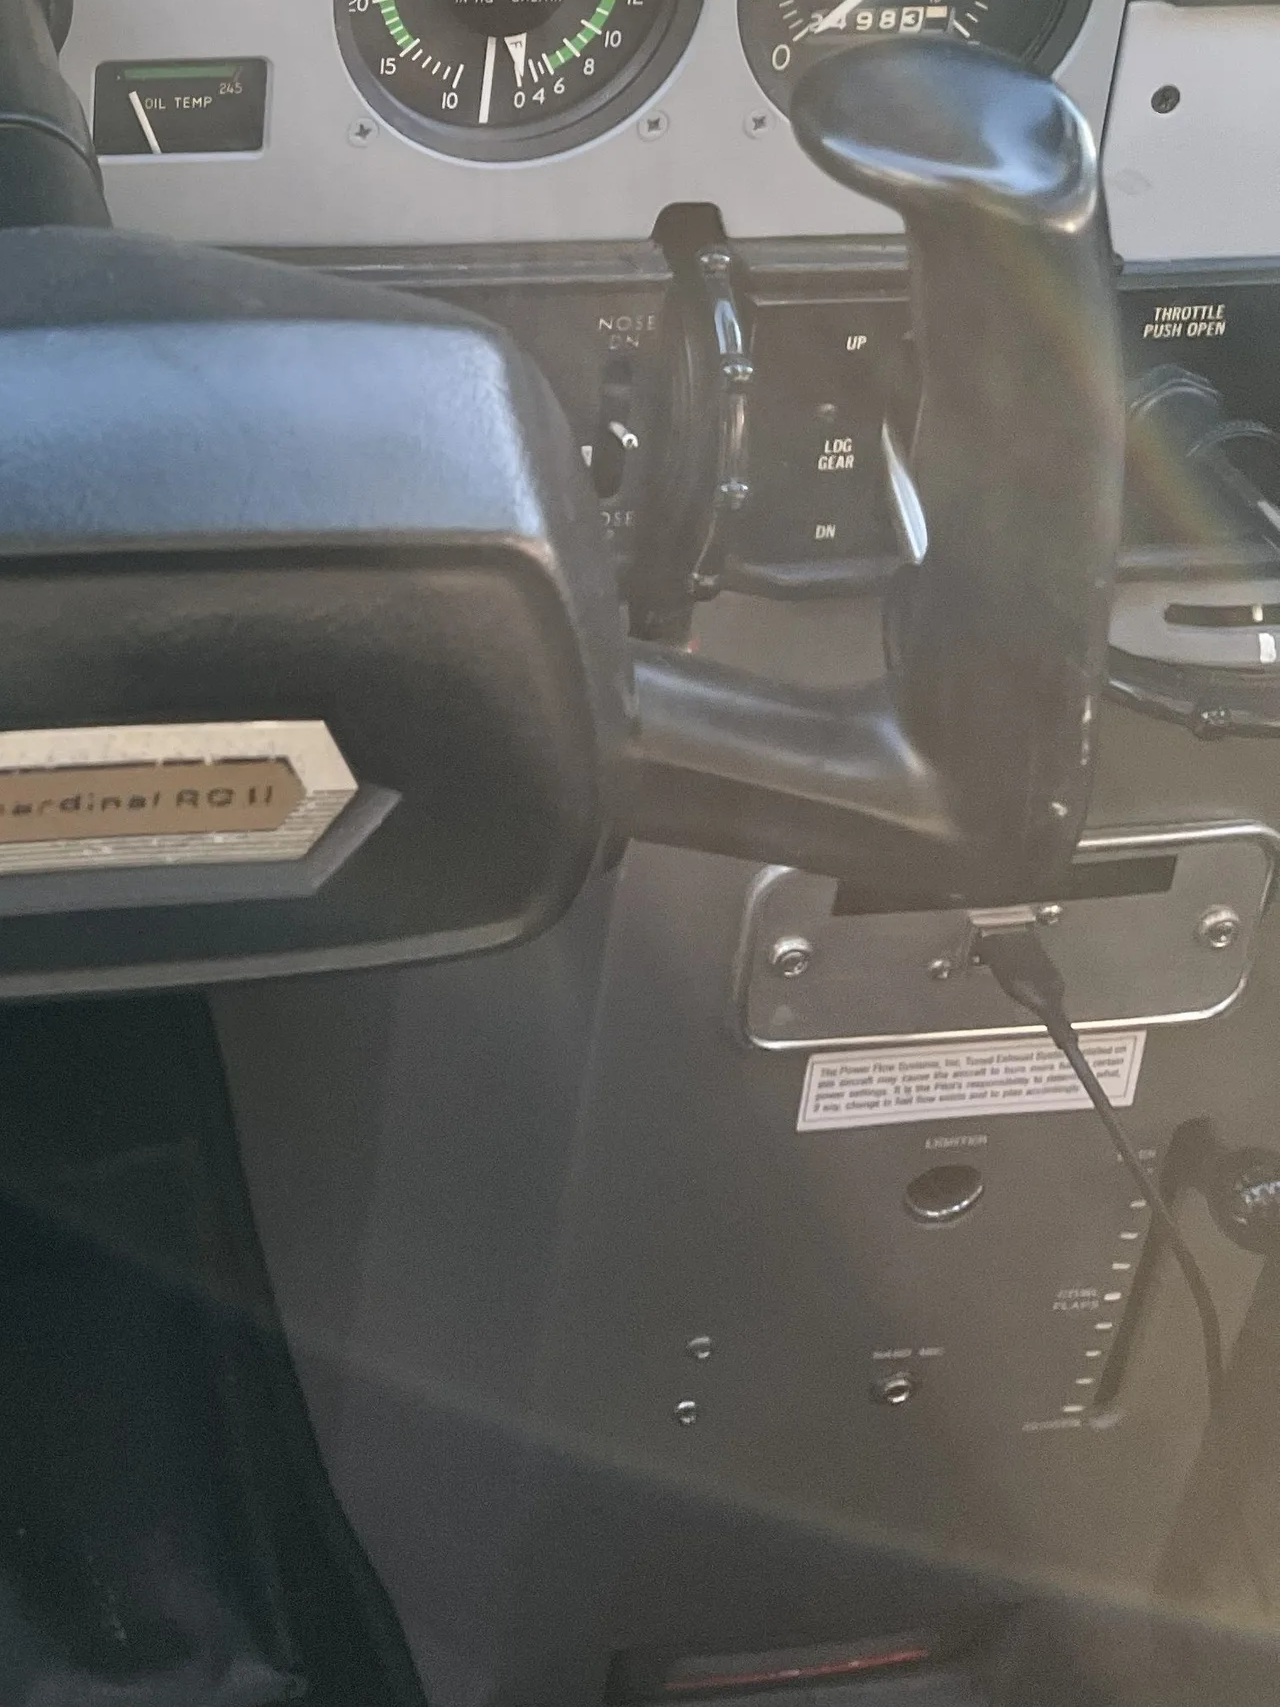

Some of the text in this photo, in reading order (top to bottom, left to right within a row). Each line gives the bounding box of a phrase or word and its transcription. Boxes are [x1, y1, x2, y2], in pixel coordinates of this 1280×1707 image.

[145, 96, 212, 109] OIL TEMP
[1154, 305, 1225, 321] THROTTLE
[599, 315, 657, 331] NOSE
[1144, 321, 1226, 339] PUSH OPEN
[846, 335, 867, 350] UP
[818, 455, 854, 469] GEAR
[815, 524, 835, 539] DN
